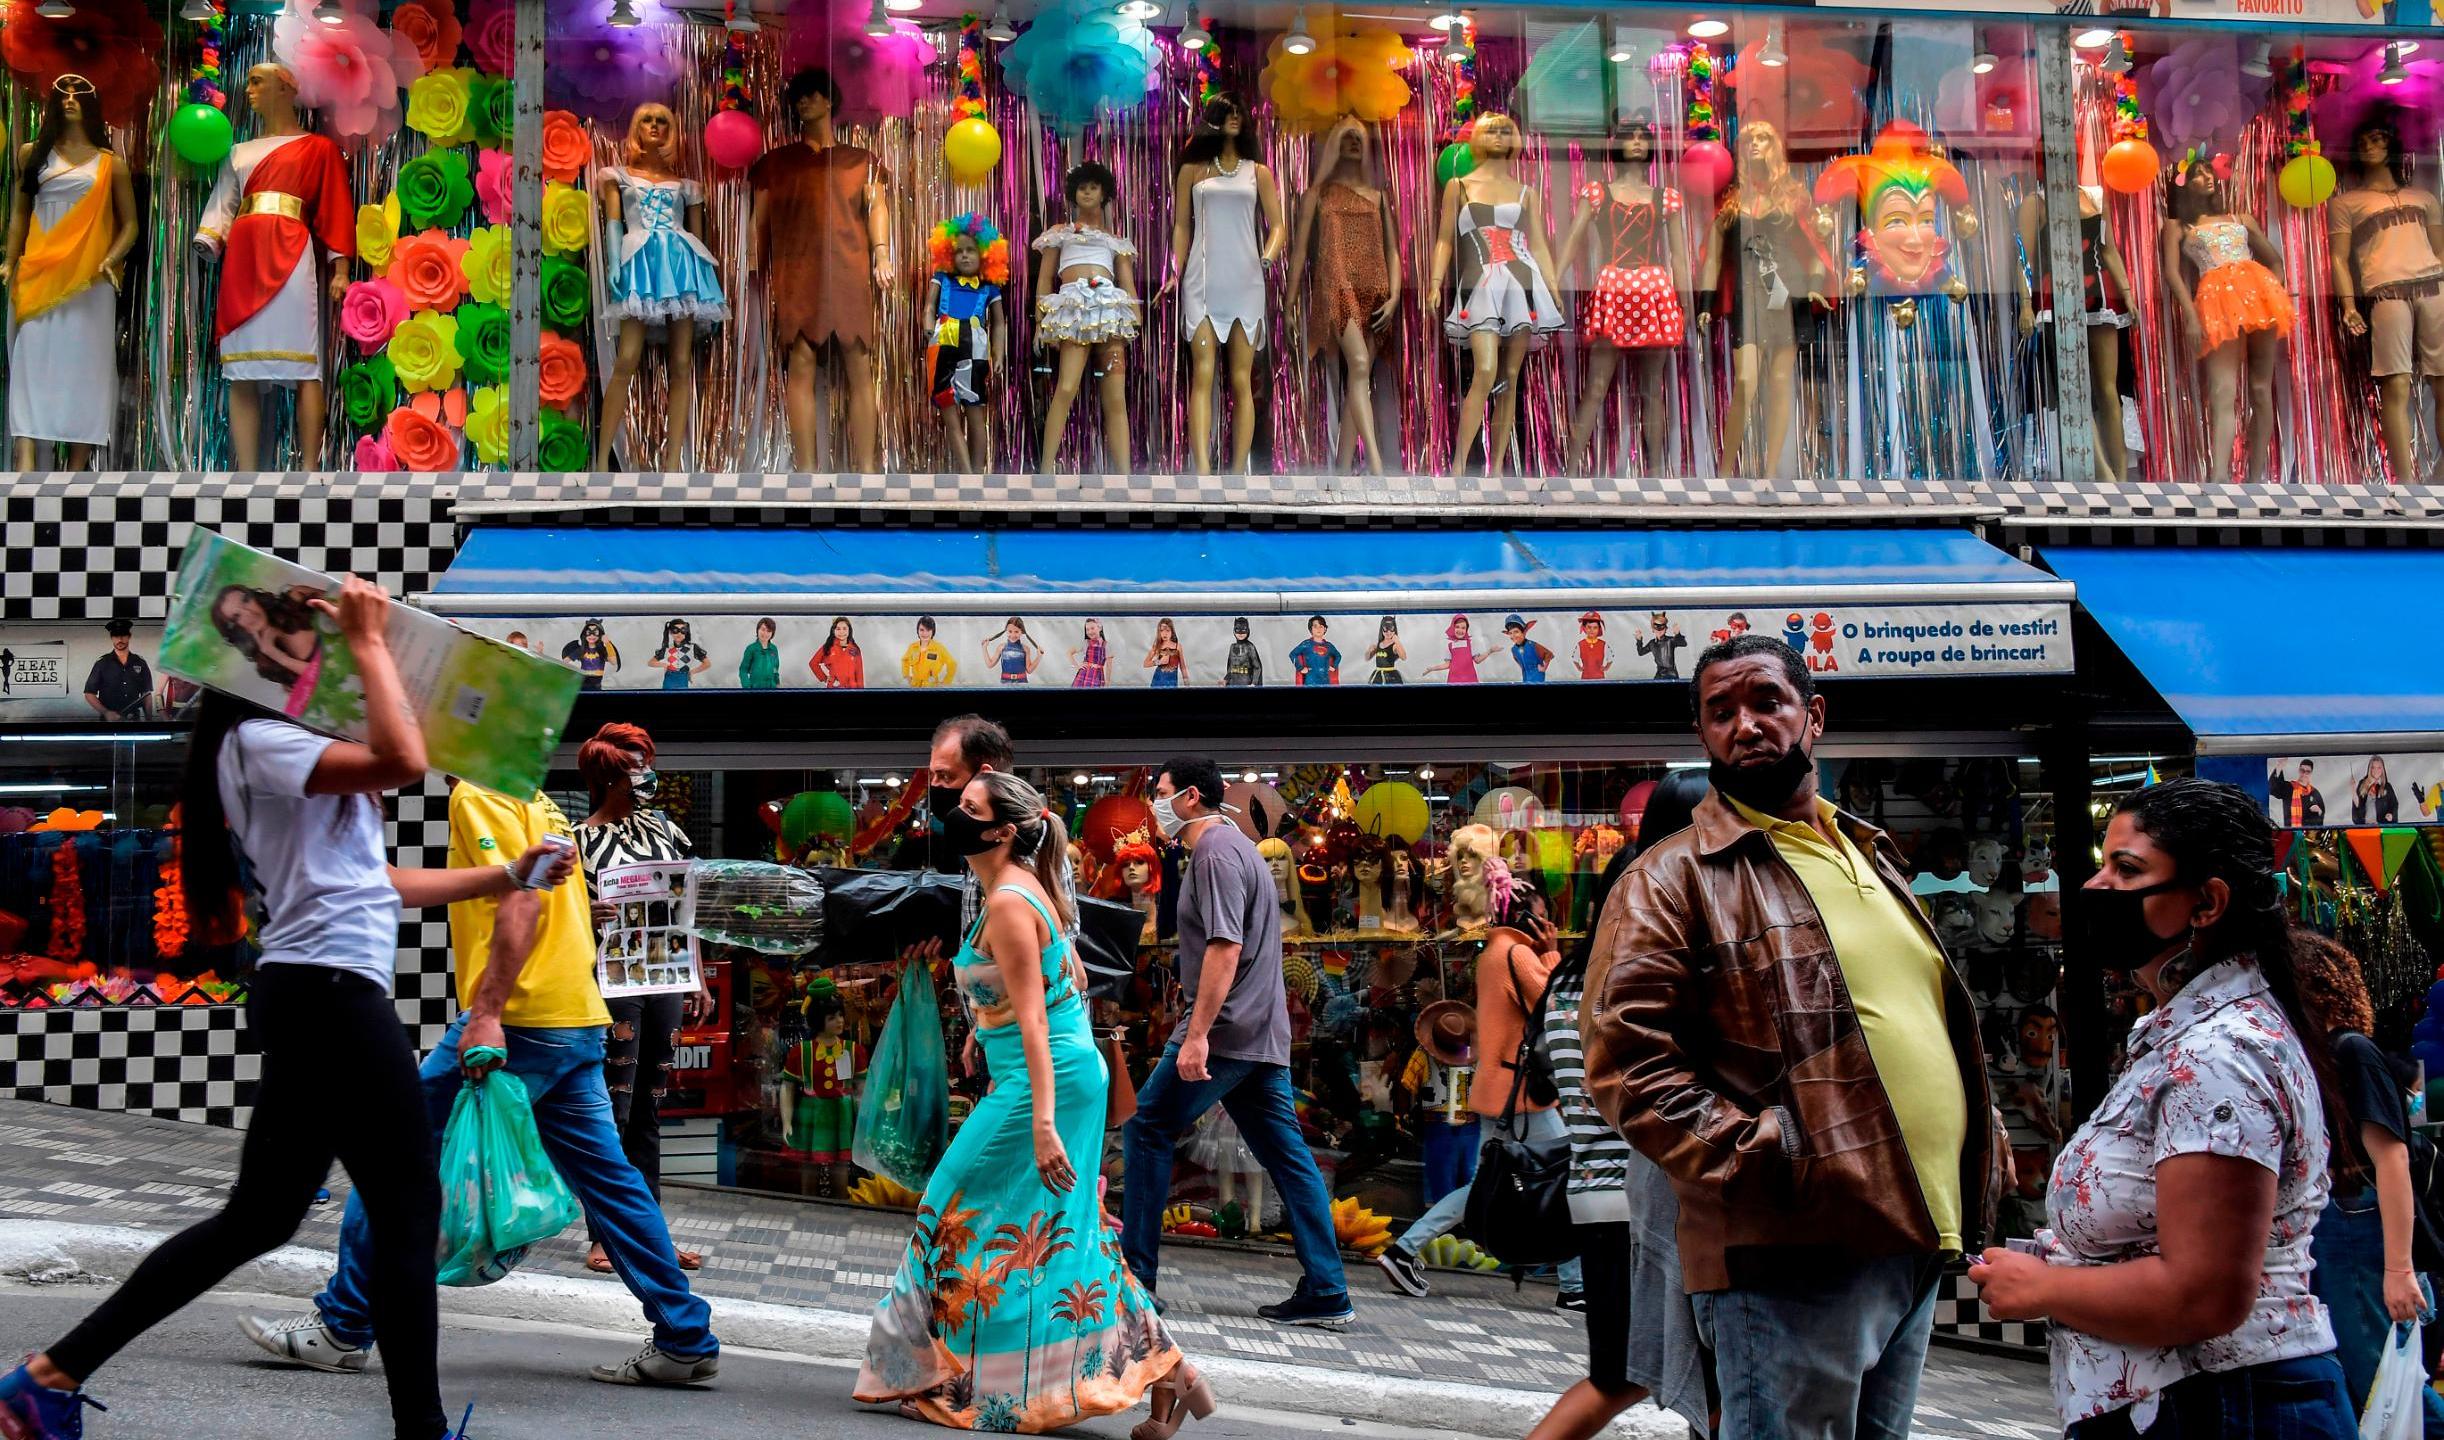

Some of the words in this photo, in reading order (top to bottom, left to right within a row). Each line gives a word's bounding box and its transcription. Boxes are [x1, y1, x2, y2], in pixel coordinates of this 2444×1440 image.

[1842, 623, 1858, 639] O
[1864, 620, 1964, 643] brinquedo
[1969, 619, 1994, 637] de
[1999, 618, 2058, 636] vestir!
[1858, 647, 1873, 663] A
[1877, 647, 1936, 667] roupa
[1941, 644, 1966, 662] de
[1970, 643, 2046, 661] brincar!
[17, 660, 57, 671] HEAT
[14, 671, 58, 683] GIRLS
